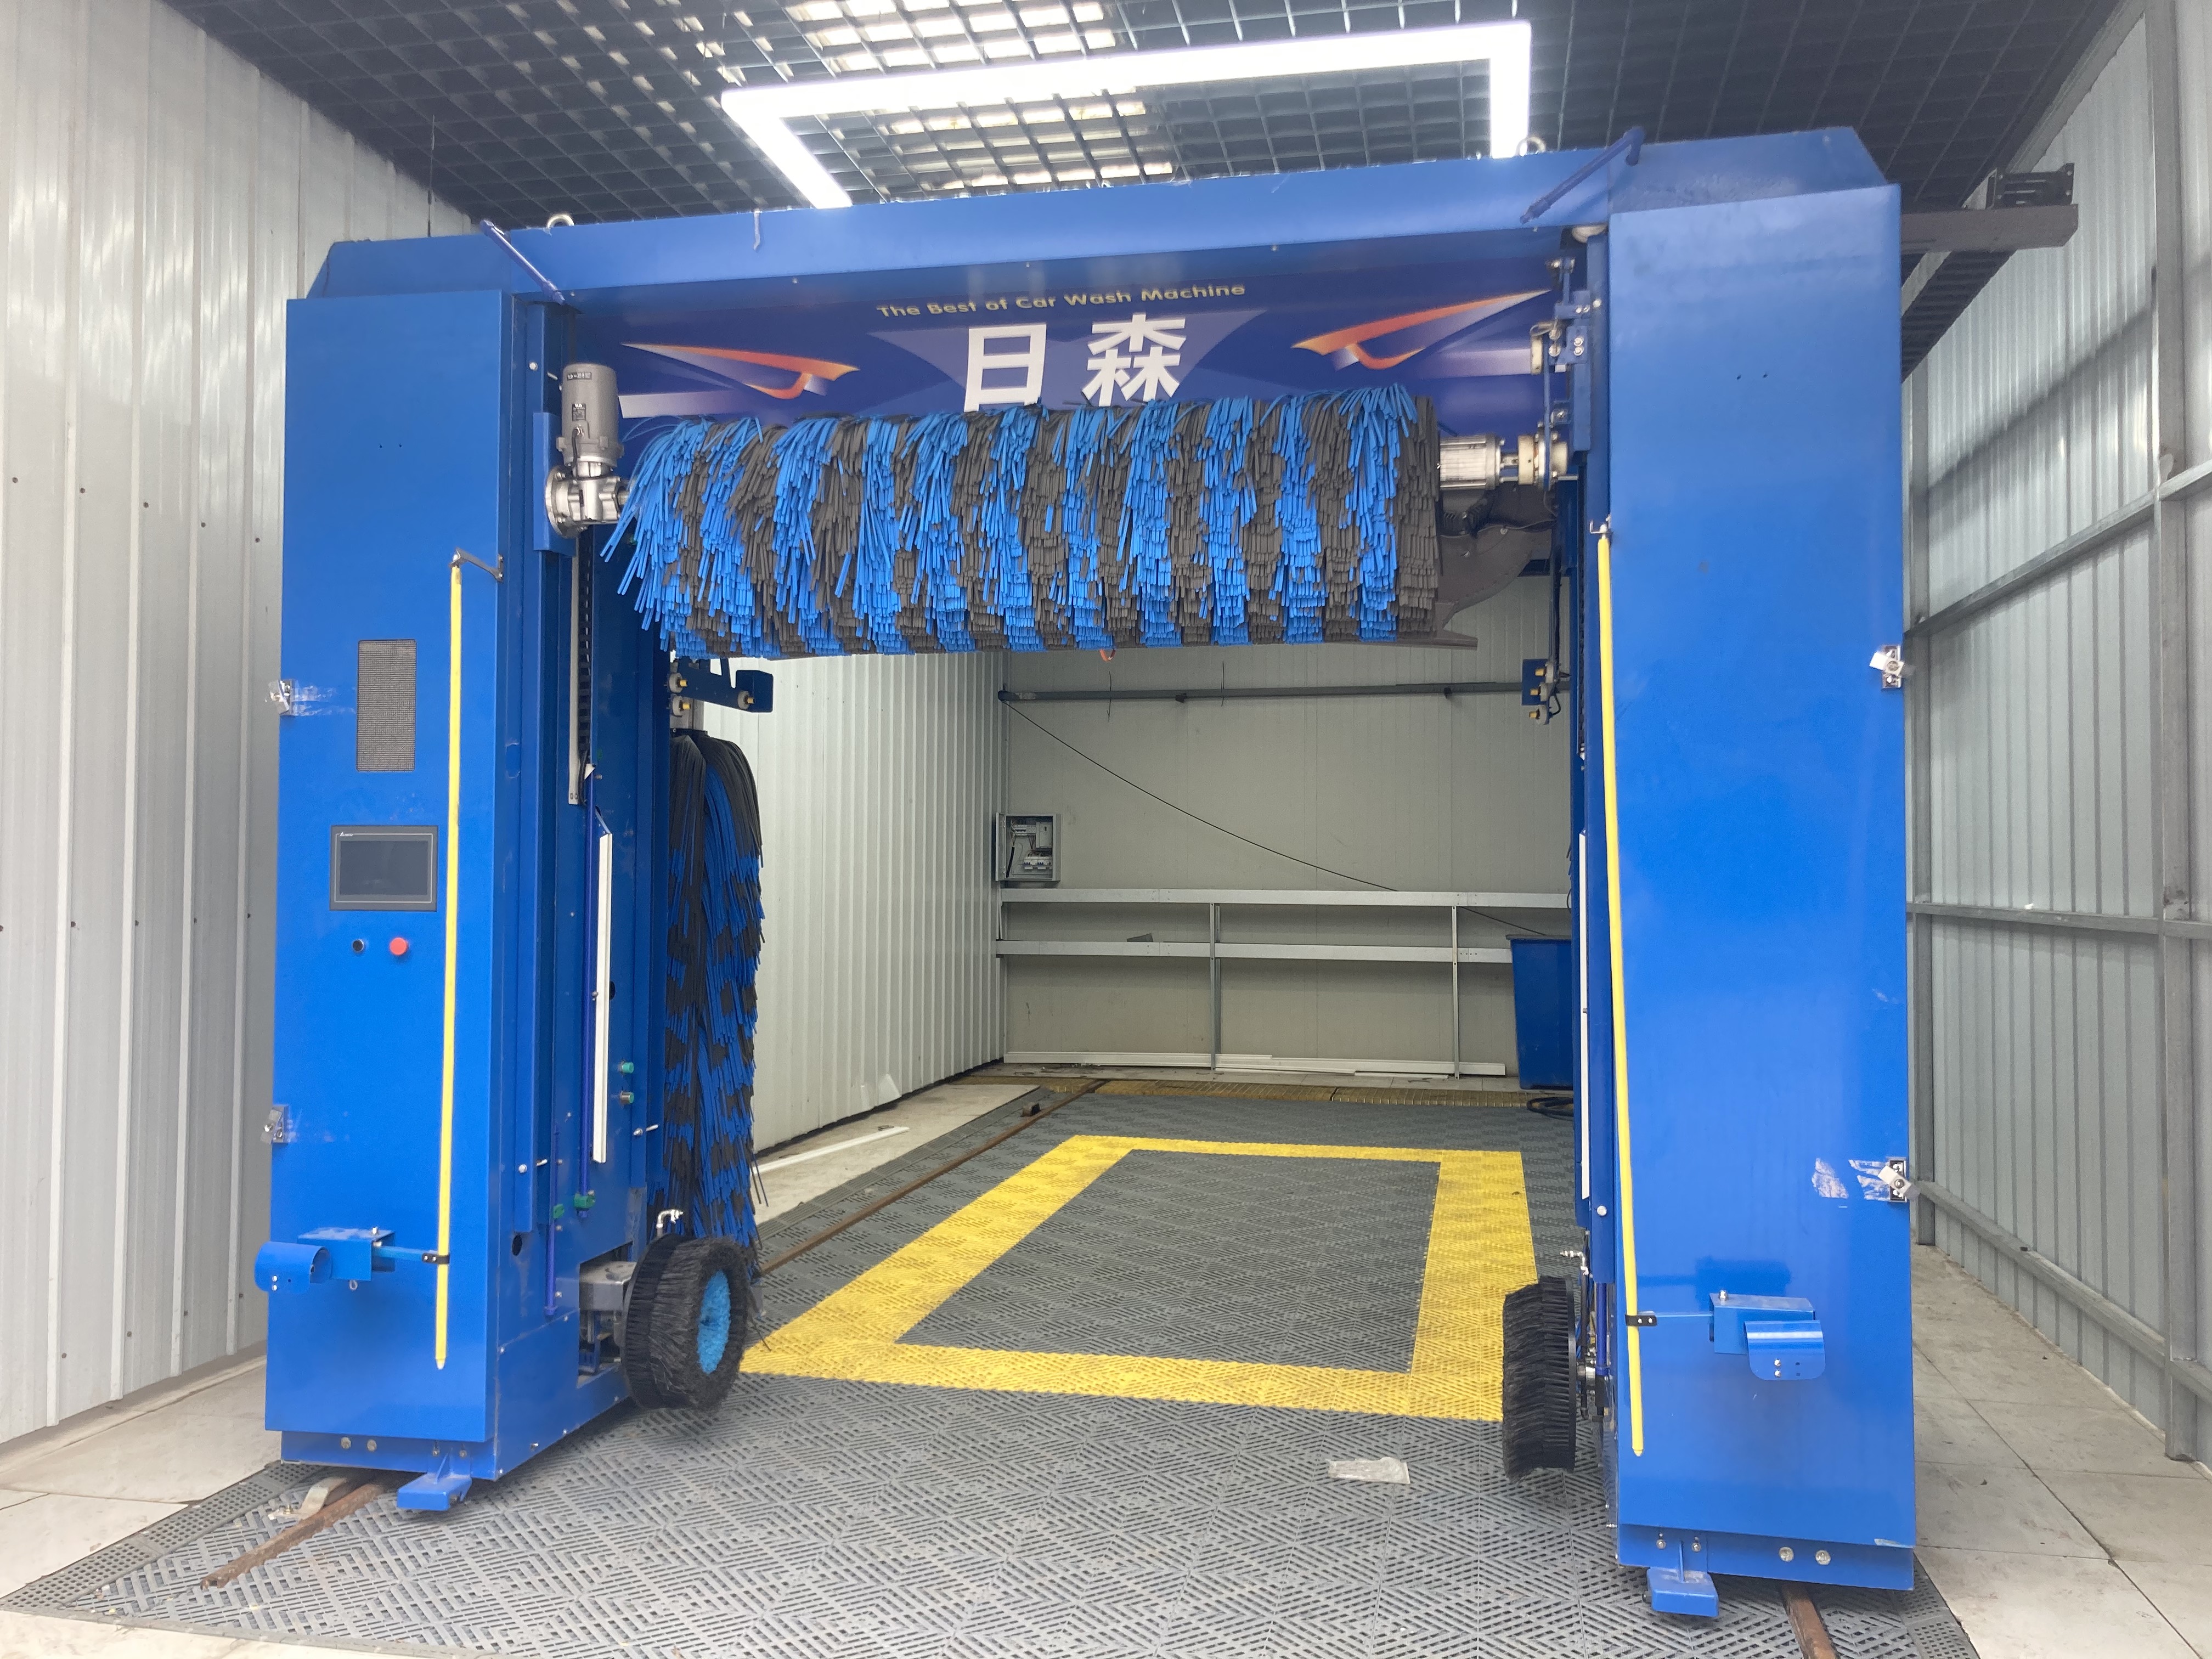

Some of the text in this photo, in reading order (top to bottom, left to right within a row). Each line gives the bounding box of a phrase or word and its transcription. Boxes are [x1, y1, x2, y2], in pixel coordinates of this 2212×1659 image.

[877, 284, 1245, 317] The Best of Car Wash Machine
[964, 312, 1187, 412] 日森
